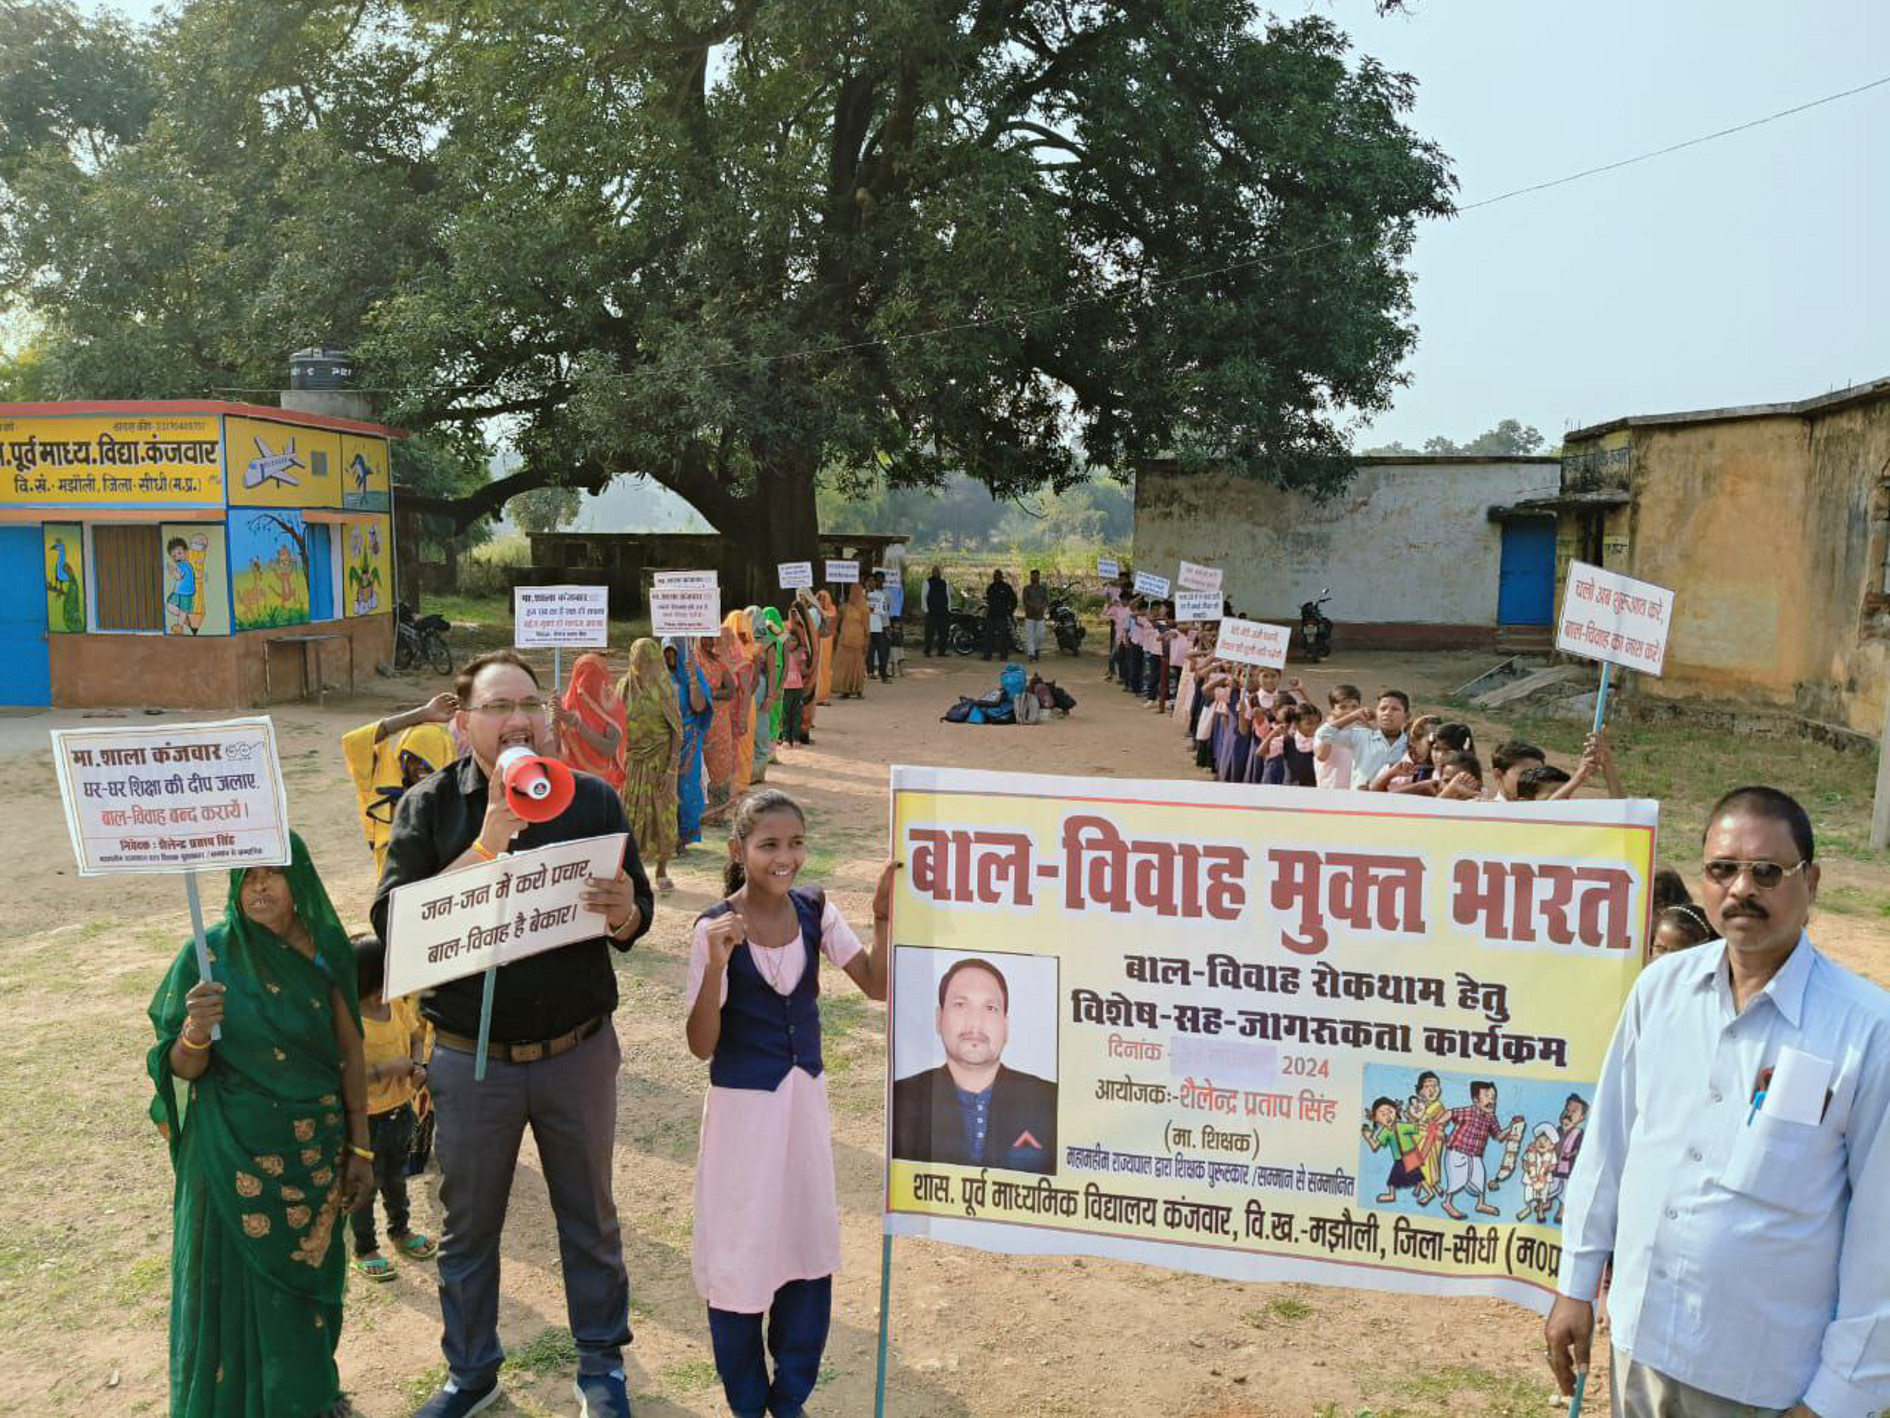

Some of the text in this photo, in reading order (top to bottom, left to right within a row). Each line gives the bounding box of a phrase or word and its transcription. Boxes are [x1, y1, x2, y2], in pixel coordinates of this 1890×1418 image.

[70, 741, 222, 767] मा.शाला कंजवार
[128, 774, 163, 798] शिक्षा
[164, 774, 185, 796] की
[186, 772, 214, 795] दीप
[100, 804, 167, 828] बाल-विवाह
[420, 884, 492, 921] जन-जन
[494, 872, 514, 900] में
[515, 862, 548, 895] करो
[909, 814, 1635, 956] बाल-विवाह मुक्त भारत
[427, 921, 512, 964] बाल-विवाह
[513, 911, 527, 940] है
[1124, 953, 1511, 1023] बाल-विवाह रोकथाम हेतु
[1107, 1034, 1331, 1079] दिनांक 2024
[1243, 1089, 1294, 1120] प्रताप
[1298, 1089, 1339, 1124] सिंह
[1200, 1125, 1261, 1161] शिक्षक)
[1174, 1151, 1206, 1179] शिक्षक
[912, 1172, 956, 1205] शास.
[961, 1167, 989, 1217] पूर्व
[991, 1176, 1080, 1219] माध्यमिक
[1084, 1181, 1159, 1228] विद्यालय
[1163, 1194, 1239, 1242] कंजवार,
[1393, 1215, 1500, 1266] जिला-सीधी
